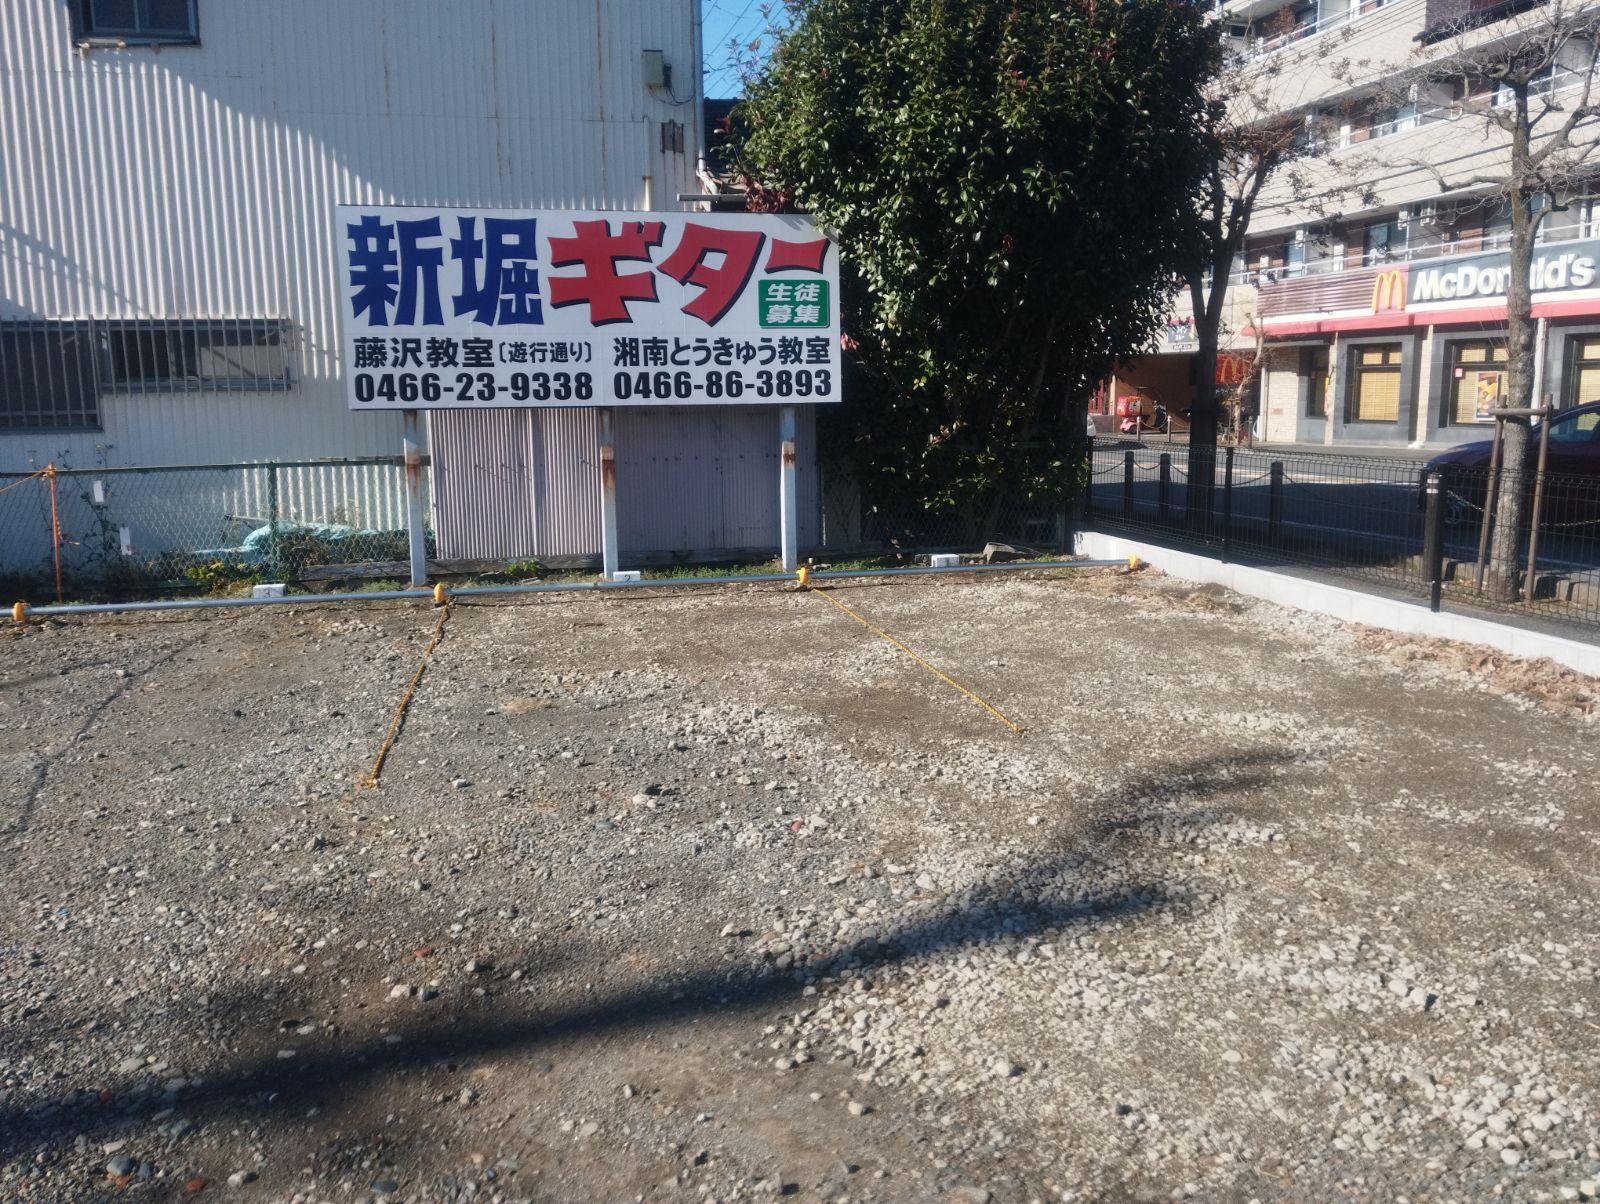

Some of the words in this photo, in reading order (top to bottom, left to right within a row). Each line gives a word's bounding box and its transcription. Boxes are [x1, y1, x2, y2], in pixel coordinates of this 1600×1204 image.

[346, 215, 831, 328] 新堀ギター
[1412, 253, 1596, 301] McDonld's
[765, 283, 821, 302] 生徒
[765, 304, 821, 324] 募集
[613, 336, 831, 367] 湘南とうきゅう教室
[354, 372, 593, 402] 0466-23-9338
[613, 369, 832, 399] 0466-86-3893
